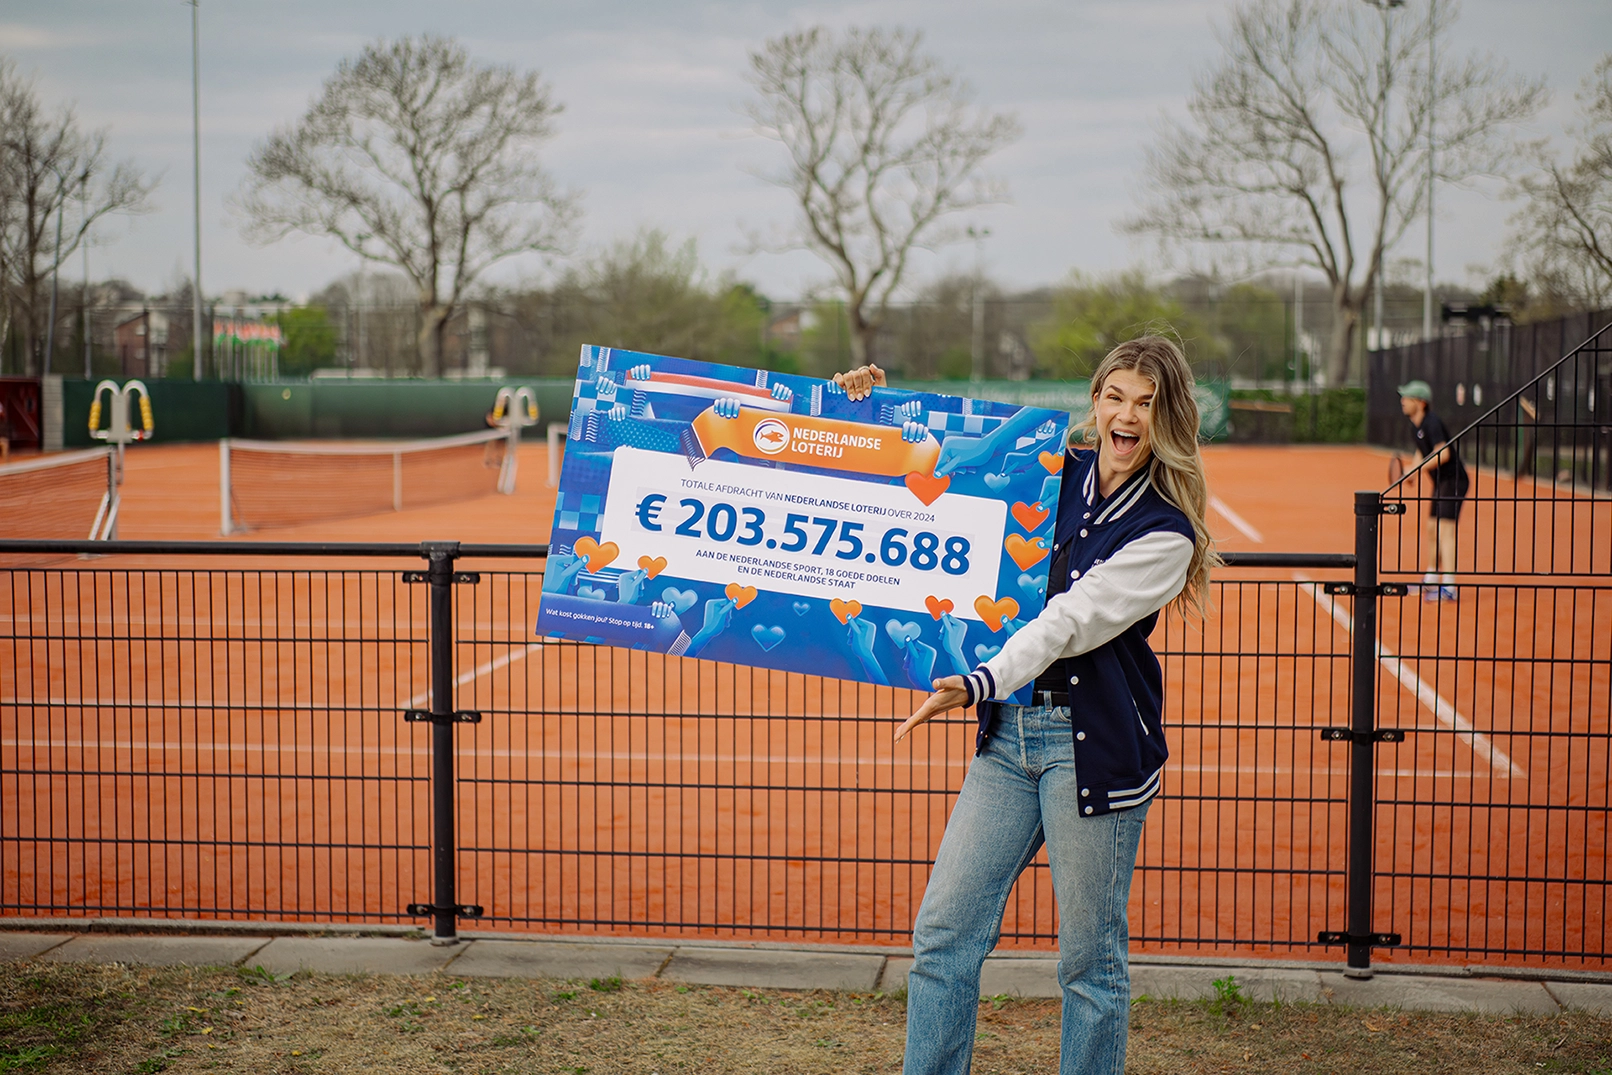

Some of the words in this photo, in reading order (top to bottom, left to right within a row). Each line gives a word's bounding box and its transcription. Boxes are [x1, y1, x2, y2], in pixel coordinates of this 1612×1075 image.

[791, 441, 843, 458] LOTERIJ
[793, 427, 882, 450] NEDERLANDSE
[681, 478, 714, 491] TOTALE
[715, 484, 763, 498] AFDRACHT
[765, 491, 783, 501] VAN
[784, 494, 850, 510] NEDERLANDSE
[851, 503, 886, 516] LOTERIJ
[887, 508, 912, 519] OVER
[913, 511, 935, 522] 2024
[635, 493, 667, 532] €
[675, 498, 971, 575] 203.575.688
[696, 549, 715, 559] AAN
[716, 552, 728, 561] DE
[729, 554, 792, 569] NEDERLANDSE
[793, 563, 823, 575] SPORT,
[825, 568, 834, 576] 18
[836, 569, 864, 580] GOEDE
[866, 574, 900, 585] DOELEN
[737, 566, 749, 574] EN
[751, 567, 762, 576] DE
[764, 569, 827, 585] NEDERLANDSE
[828, 578, 855, 589] STAAT
[545, 608, 558, 616] Wat
[560, 609, 572, 618] kost
[573, 612, 595, 621] gokken
[609, 617, 622, 626] Stop
